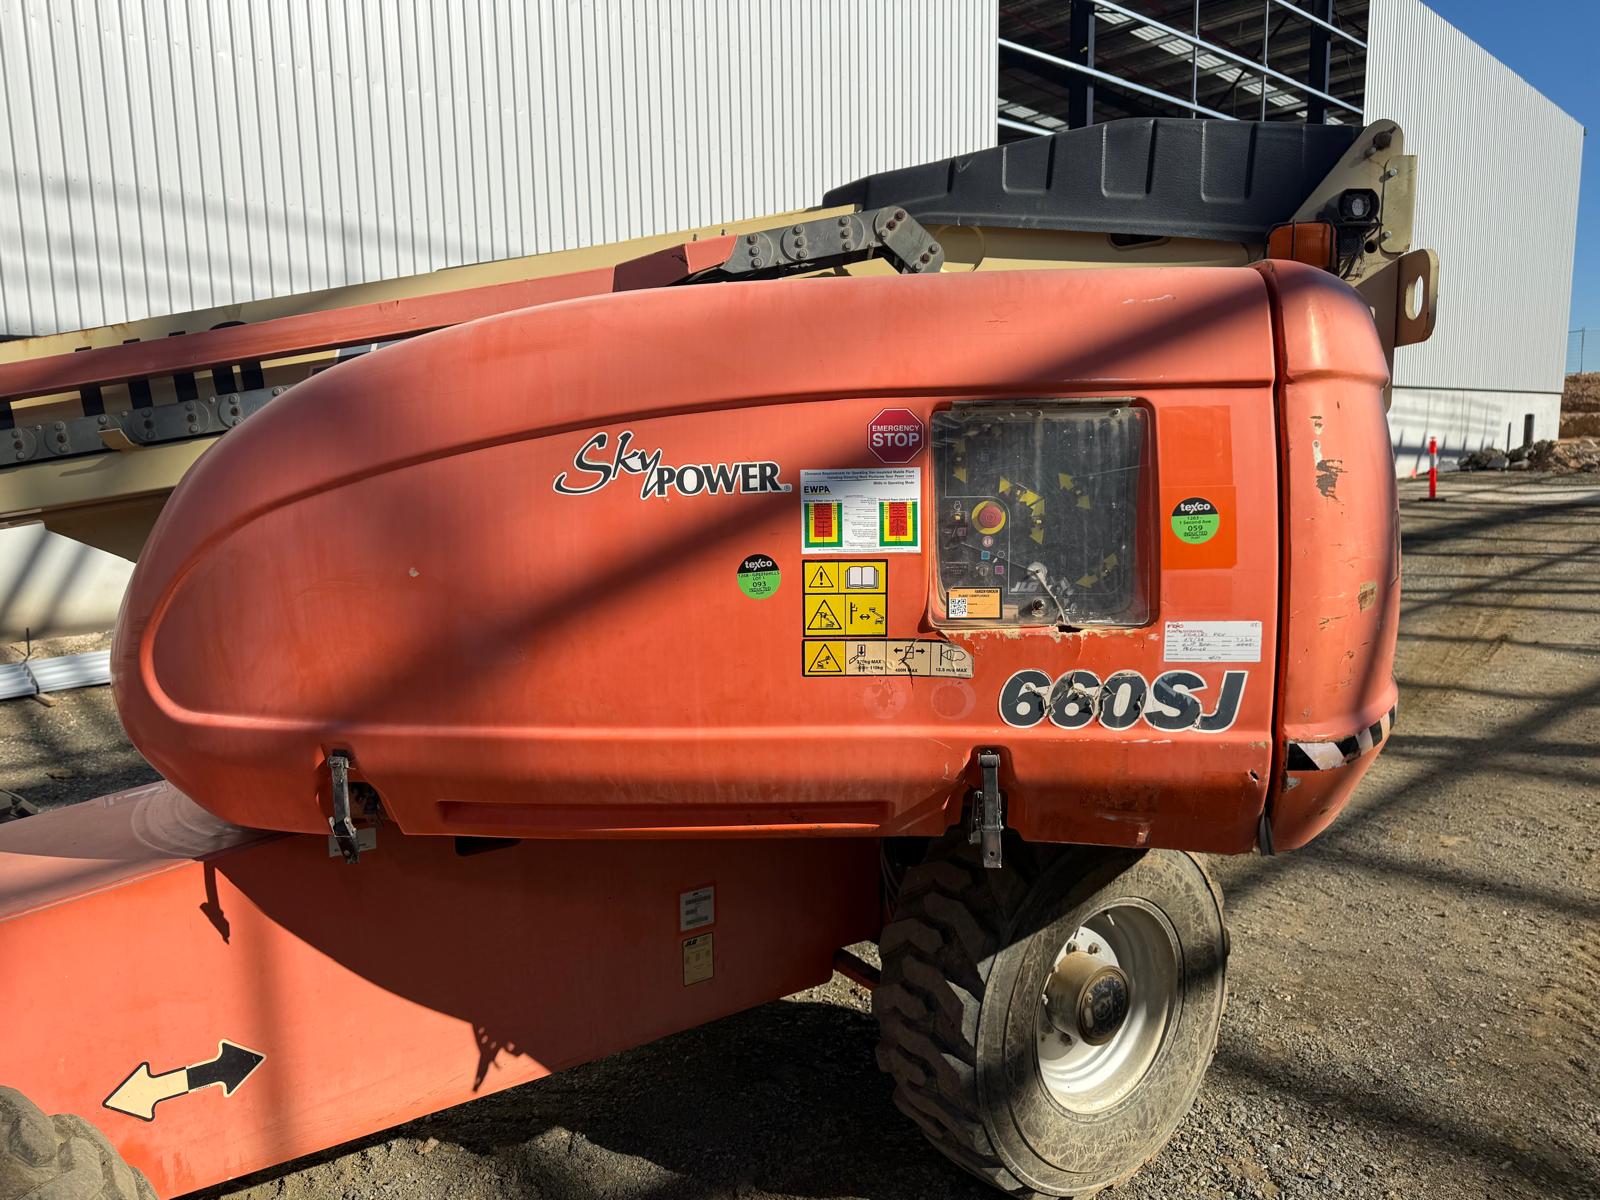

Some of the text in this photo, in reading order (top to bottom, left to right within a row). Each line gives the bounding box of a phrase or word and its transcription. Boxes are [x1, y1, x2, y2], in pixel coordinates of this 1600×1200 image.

[872, 433, 920, 447] STOP
[803, 485, 831, 494] EWPA
[1180, 502, 1211, 514] texco
[745, 559, 773, 571] texco
[998, 669, 1248, 733] 660SJ
